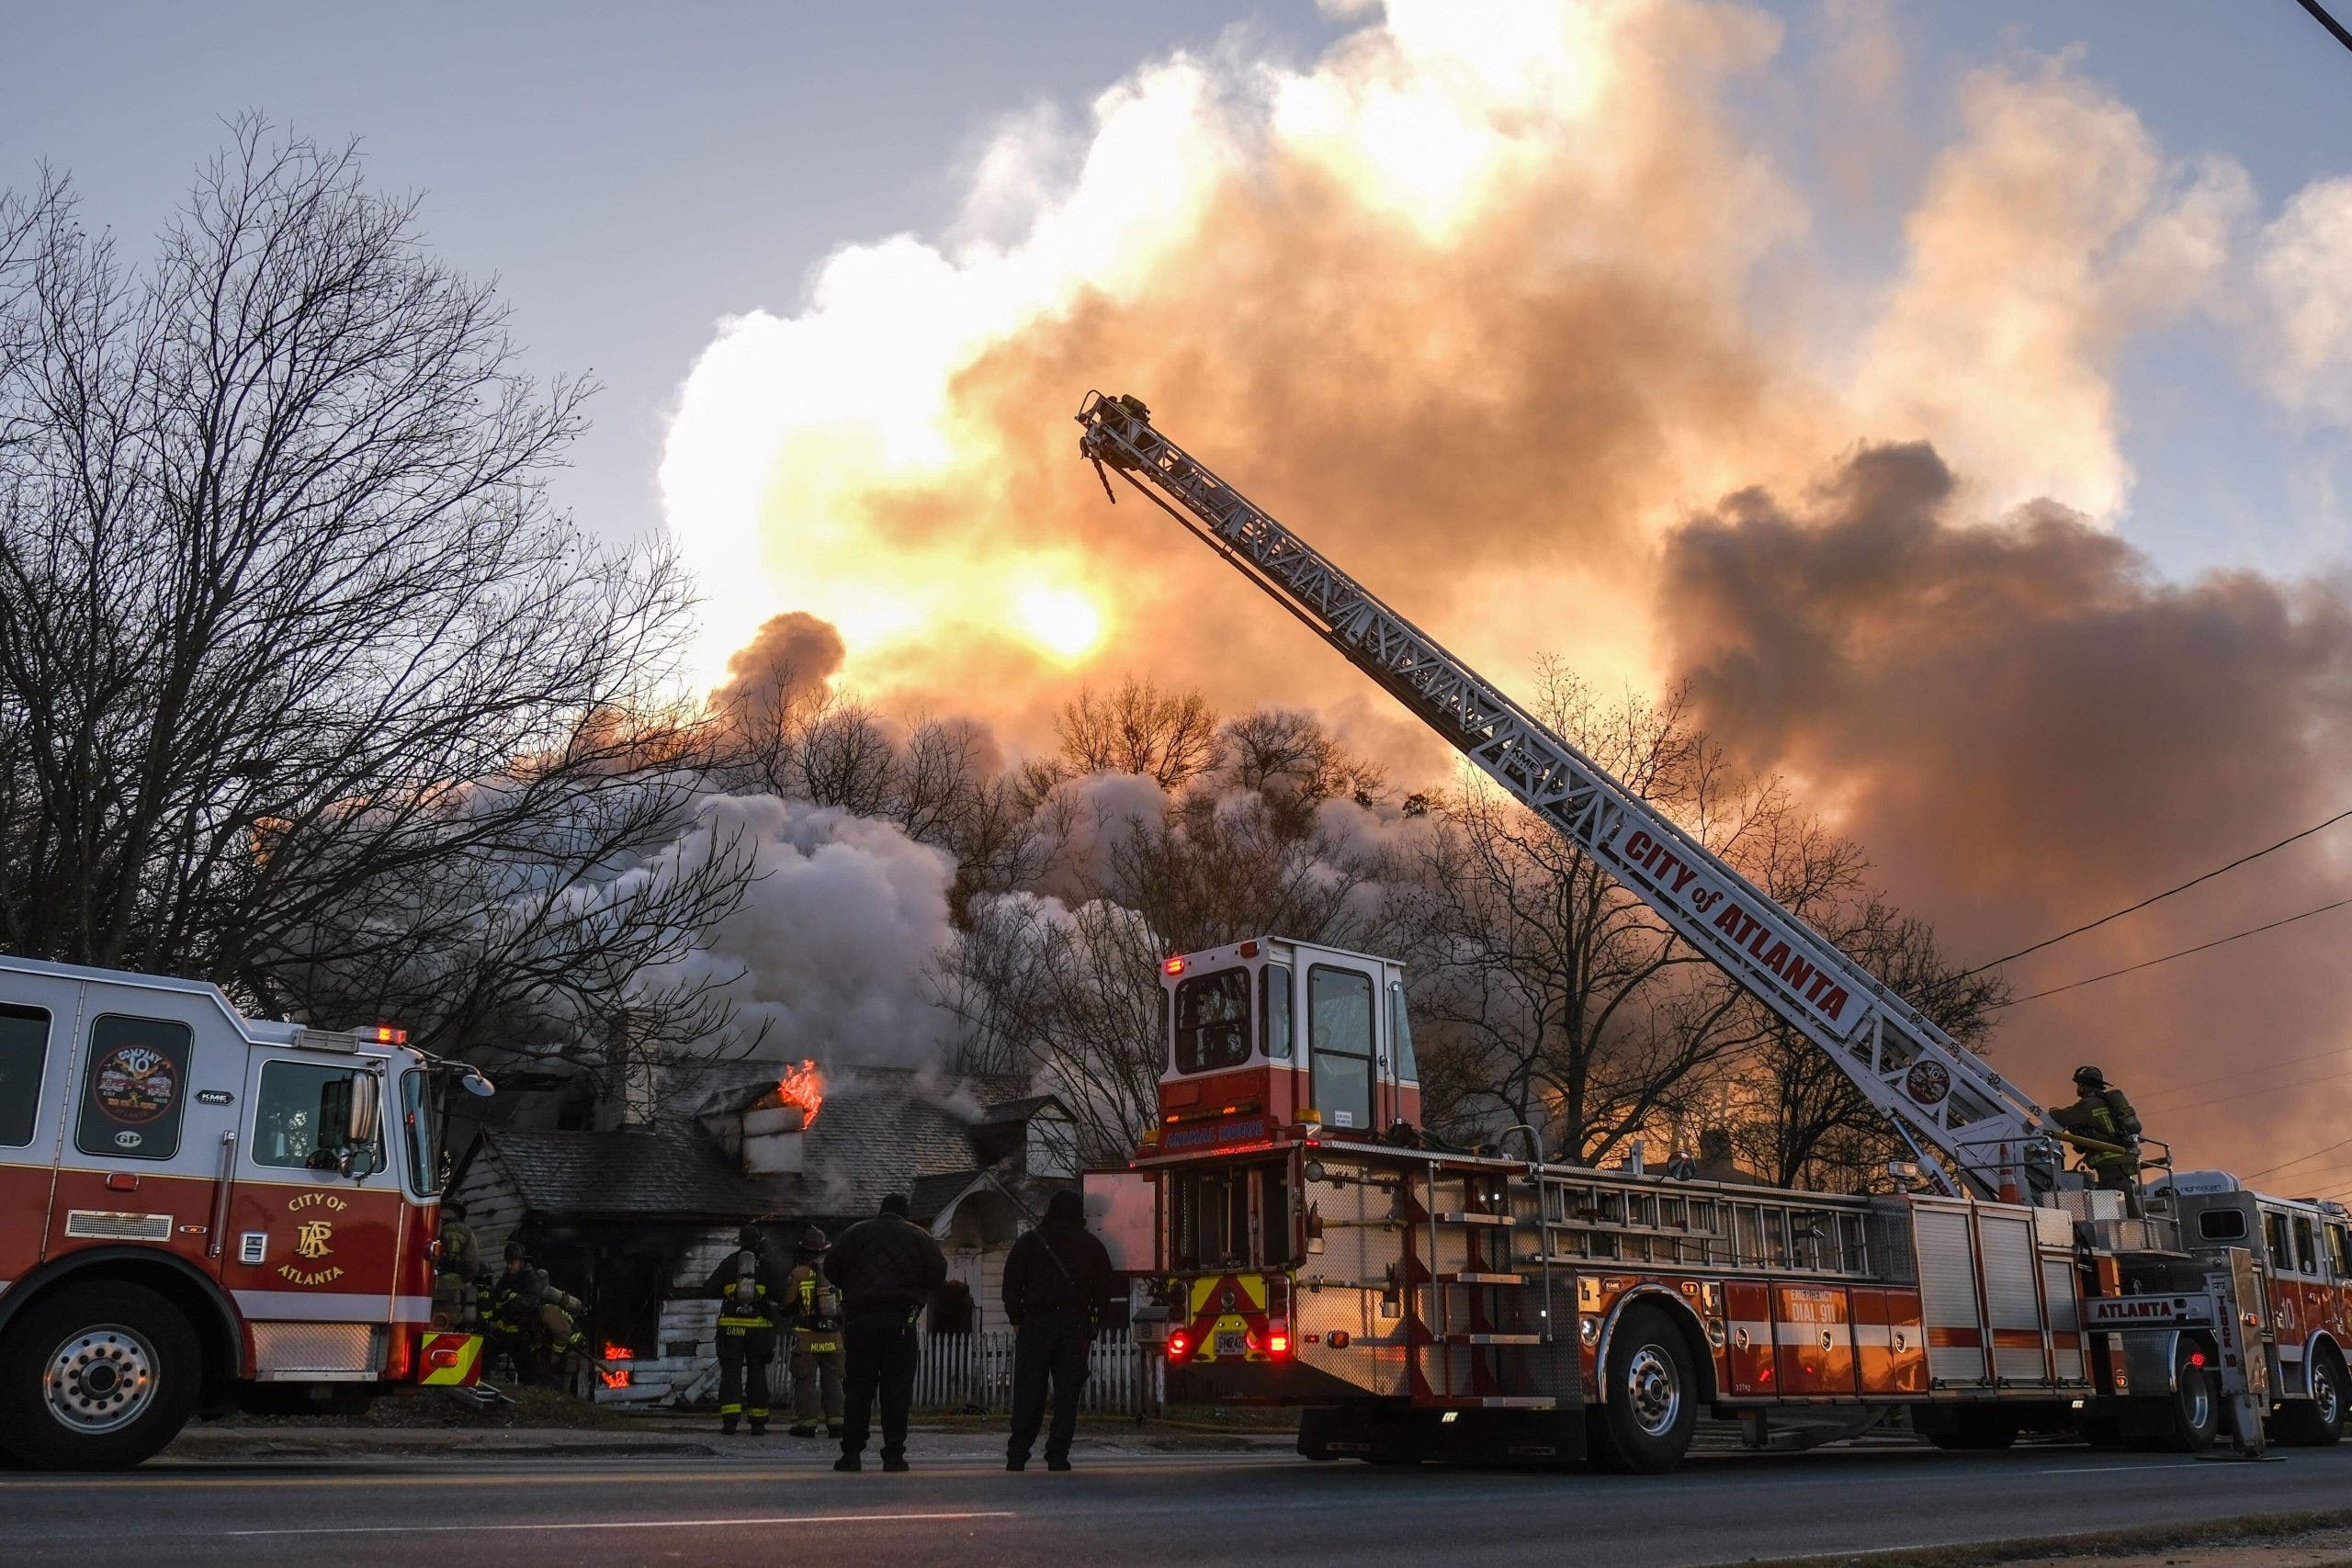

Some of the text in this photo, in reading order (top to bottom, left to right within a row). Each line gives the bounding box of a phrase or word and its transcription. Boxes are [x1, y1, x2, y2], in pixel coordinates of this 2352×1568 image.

[1511, 747, 1539, 773] KME
[1624, 830, 1849, 1021] CITY of ATLANTA
[1874, 983, 1885, 994] 65
[1911, 1012, 1923, 1024] 60
[1948, 1042, 1961, 1054] 55
[118, 1049, 163, 1064] COMPANY
[129, 1056, 150, 1072] 10
[1987, 1072, 2001, 1085] 50
[202, 1093, 227, 1101] KME
[2028, 1104, 2042, 1117] 45
[119, 1134, 138, 1144] GP
[288, 1193, 347, 1213] CITY OF
[277, 1264, 345, 1285] ATLANTA
[1791, 1289, 1833, 1302] EMERGENCY
[1792, 1303, 1837, 1323] DIAL 911
[2098, 1302, 2172, 1319] ATLANTA
[2280, 1297, 2295, 1330] 10
[2217, 1295, 2233, 1348] TRUCK
[726, 1325, 746, 1337] DANN
[810, 1341, 836, 1353] MUNSON
[2224, 1354, 2237, 1368] 10
